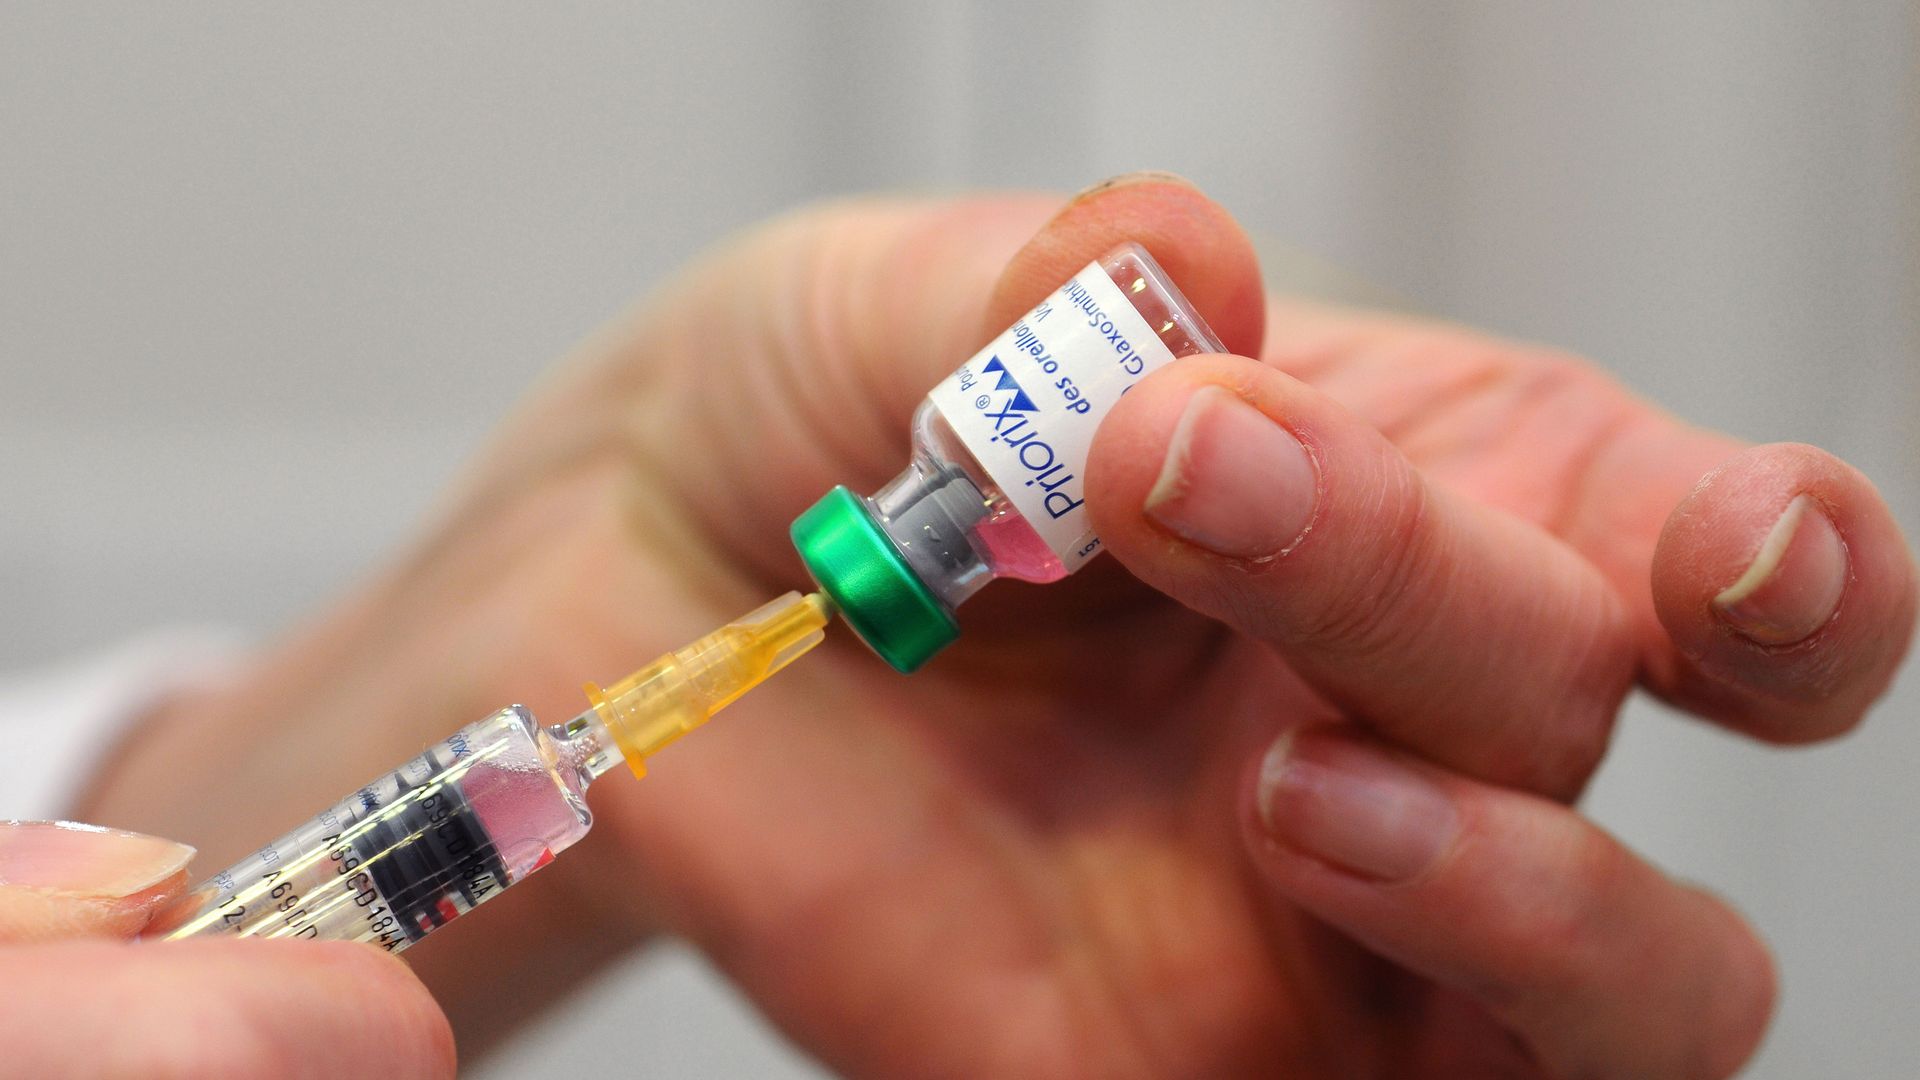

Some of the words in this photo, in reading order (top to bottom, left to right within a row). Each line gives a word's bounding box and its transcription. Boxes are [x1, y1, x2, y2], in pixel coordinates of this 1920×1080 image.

[1011, 319, 1058, 375] oreillon
[1062, 279, 1145, 375] GlaxoSmithK
[1055, 376, 1091, 414] des
[219, 895, 247, 933] 12-
[263, 870, 318, 939] A69DD
[322, 833, 406, 952] A69CD184A
